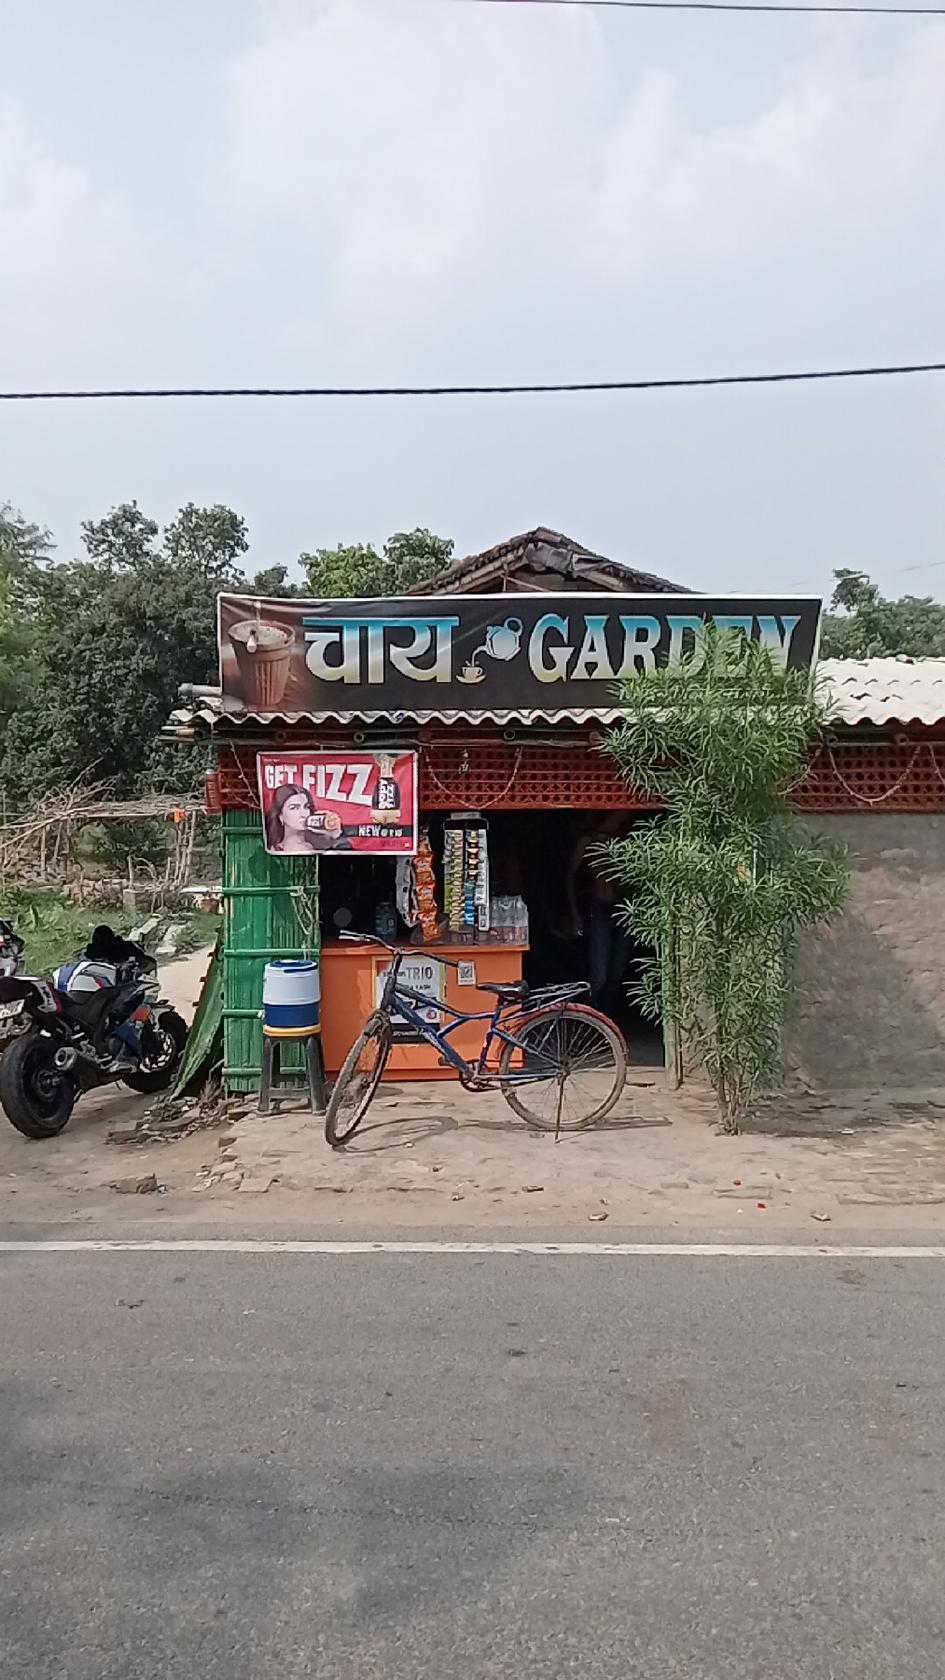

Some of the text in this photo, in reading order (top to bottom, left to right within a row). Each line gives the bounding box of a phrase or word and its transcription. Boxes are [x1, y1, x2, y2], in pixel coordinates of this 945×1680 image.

[303, 616, 460, 684] चाय
[264, 763, 374, 807] GET FIZZ
[358, 824, 382, 837] NEW
[406, 966, 434, 980] TRIO
